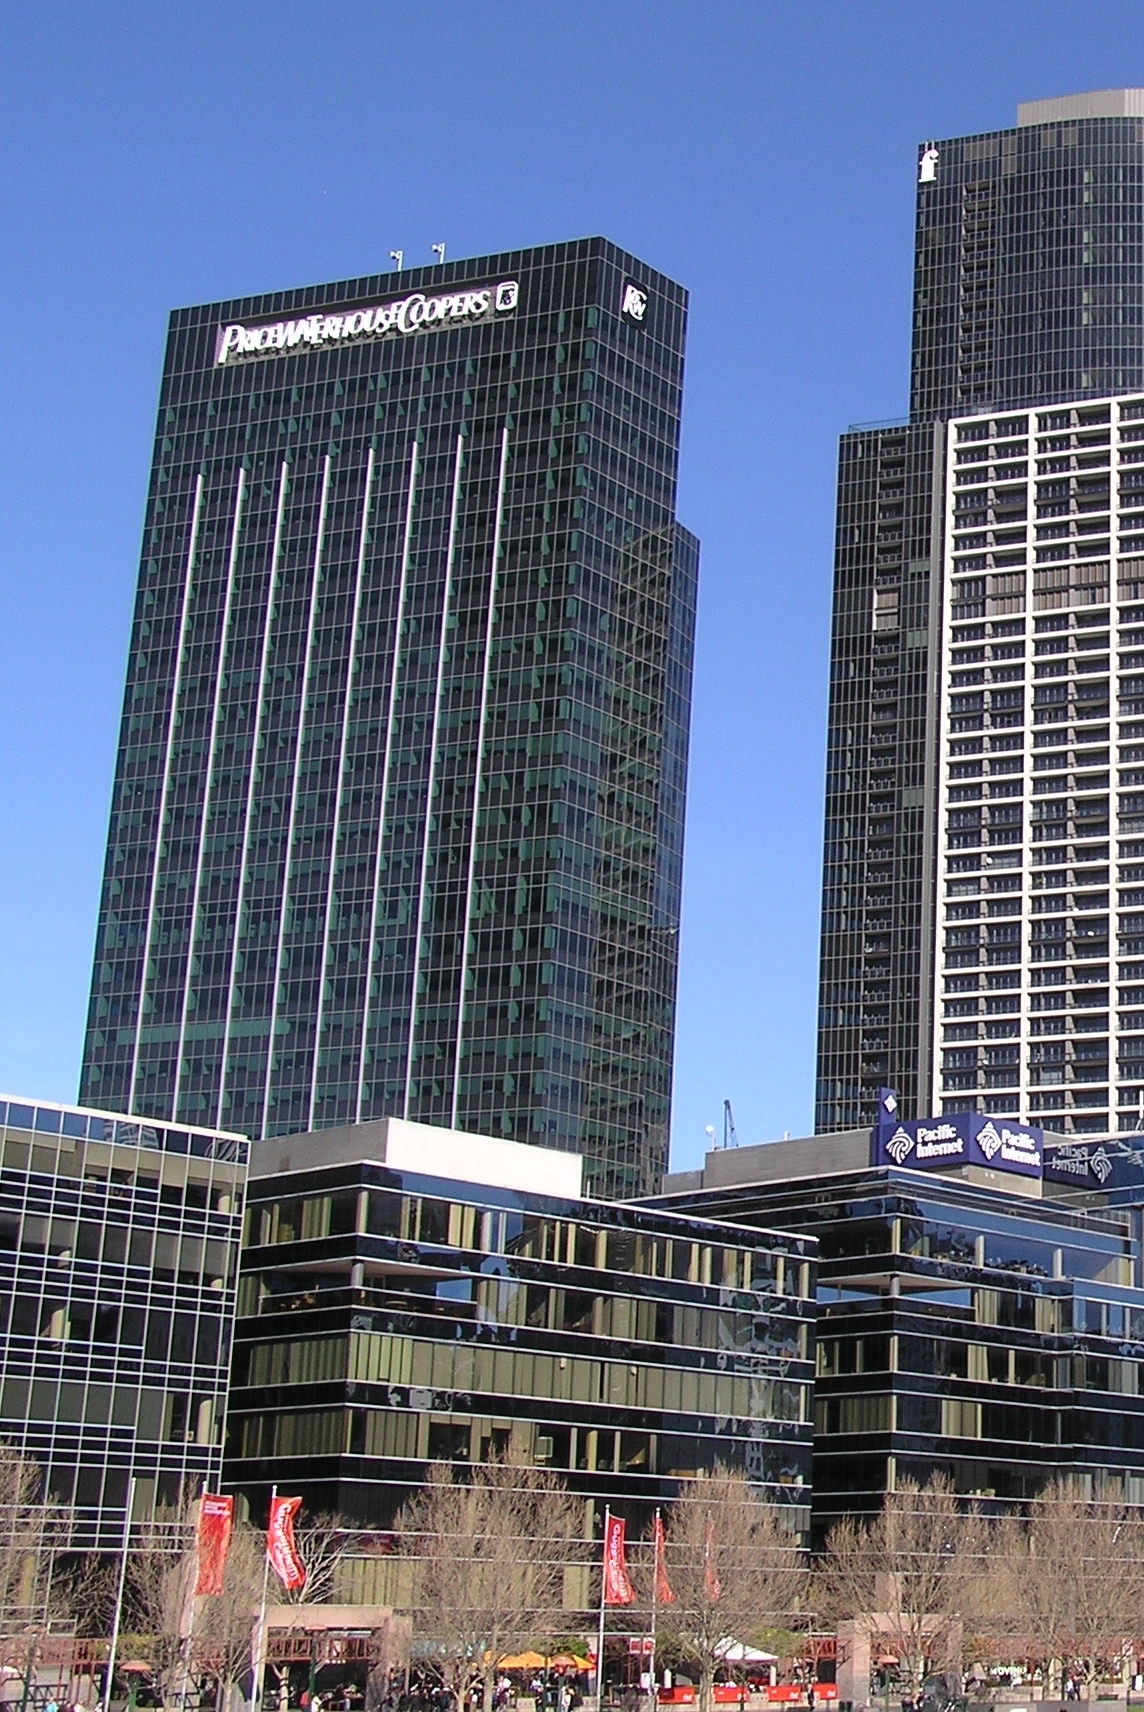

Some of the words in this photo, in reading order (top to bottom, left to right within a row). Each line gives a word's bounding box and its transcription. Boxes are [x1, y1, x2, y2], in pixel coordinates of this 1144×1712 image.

[917, 1124, 957, 1142] Pacific
[1001, 1129, 1035, 1150] Pacific
[917, 1138, 963, 1158] Internet
[1001, 1144, 1040, 1166] Internet
